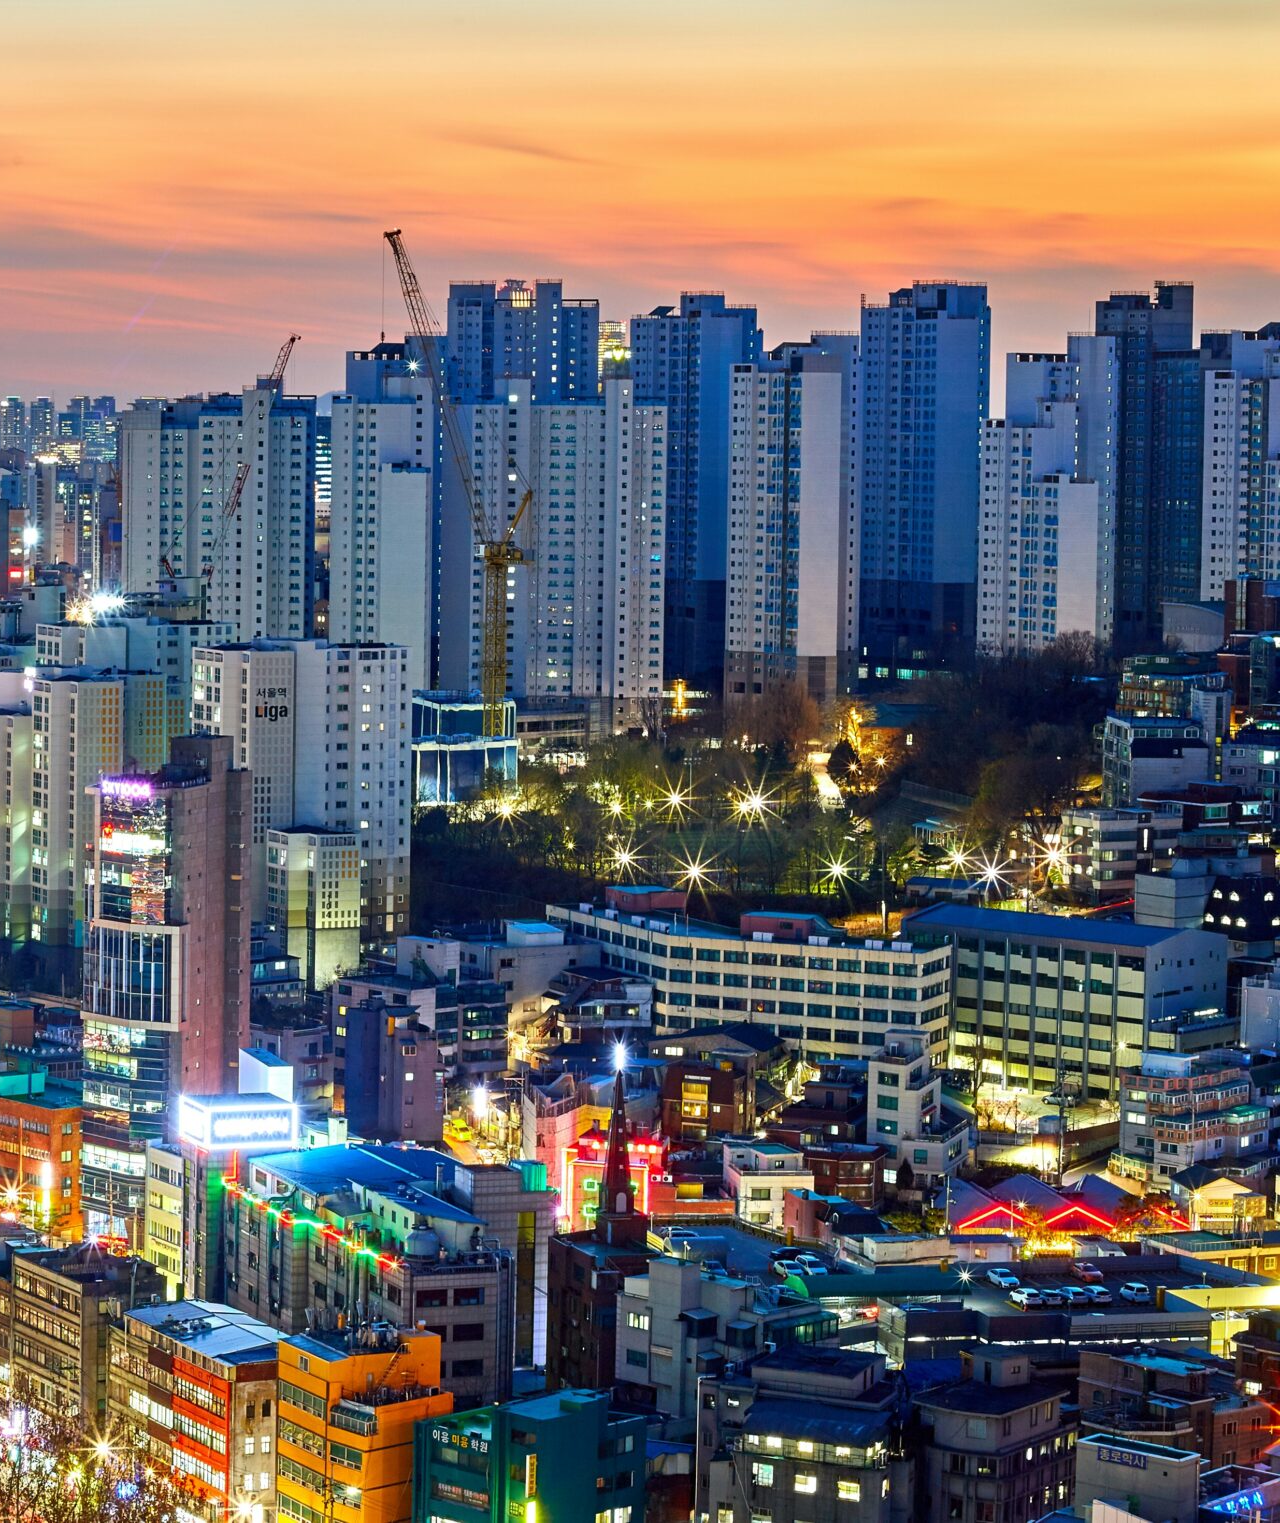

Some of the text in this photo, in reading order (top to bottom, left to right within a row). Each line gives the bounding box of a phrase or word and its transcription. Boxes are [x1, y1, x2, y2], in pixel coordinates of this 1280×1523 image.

[256, 687, 287, 699] 서울역
[255, 701, 288, 722] Liga
[432, 1429, 489, 1453] 이용 미용 학원
[1099, 1447, 1145, 1468] 종로학사
